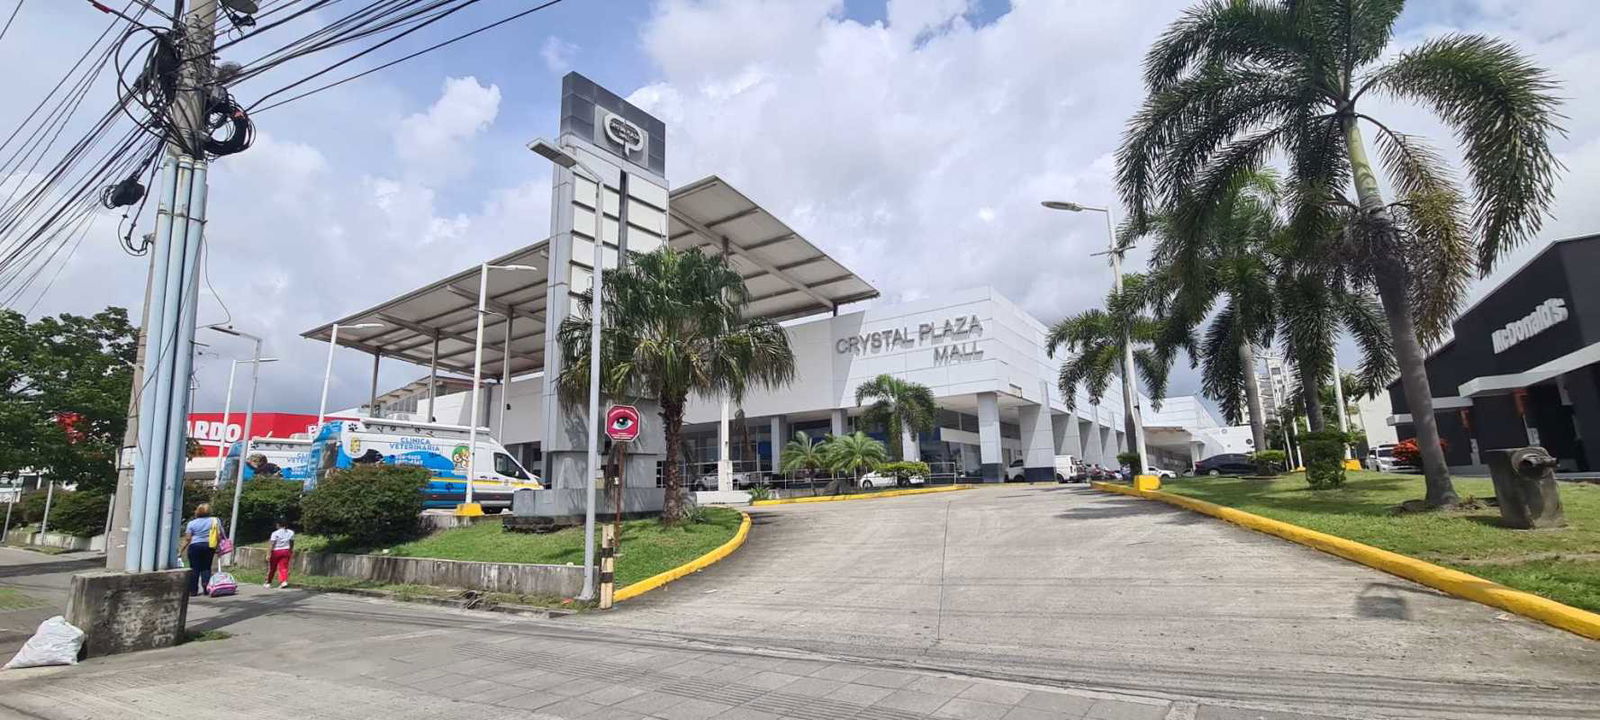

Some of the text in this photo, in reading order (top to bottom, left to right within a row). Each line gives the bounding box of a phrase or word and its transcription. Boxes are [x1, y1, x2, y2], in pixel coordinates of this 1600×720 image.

[836, 314, 983, 355] CRYSTAL PLAZA
[1491, 298, 1568, 354] McDonald's
[934, 341, 984, 362] MALL
